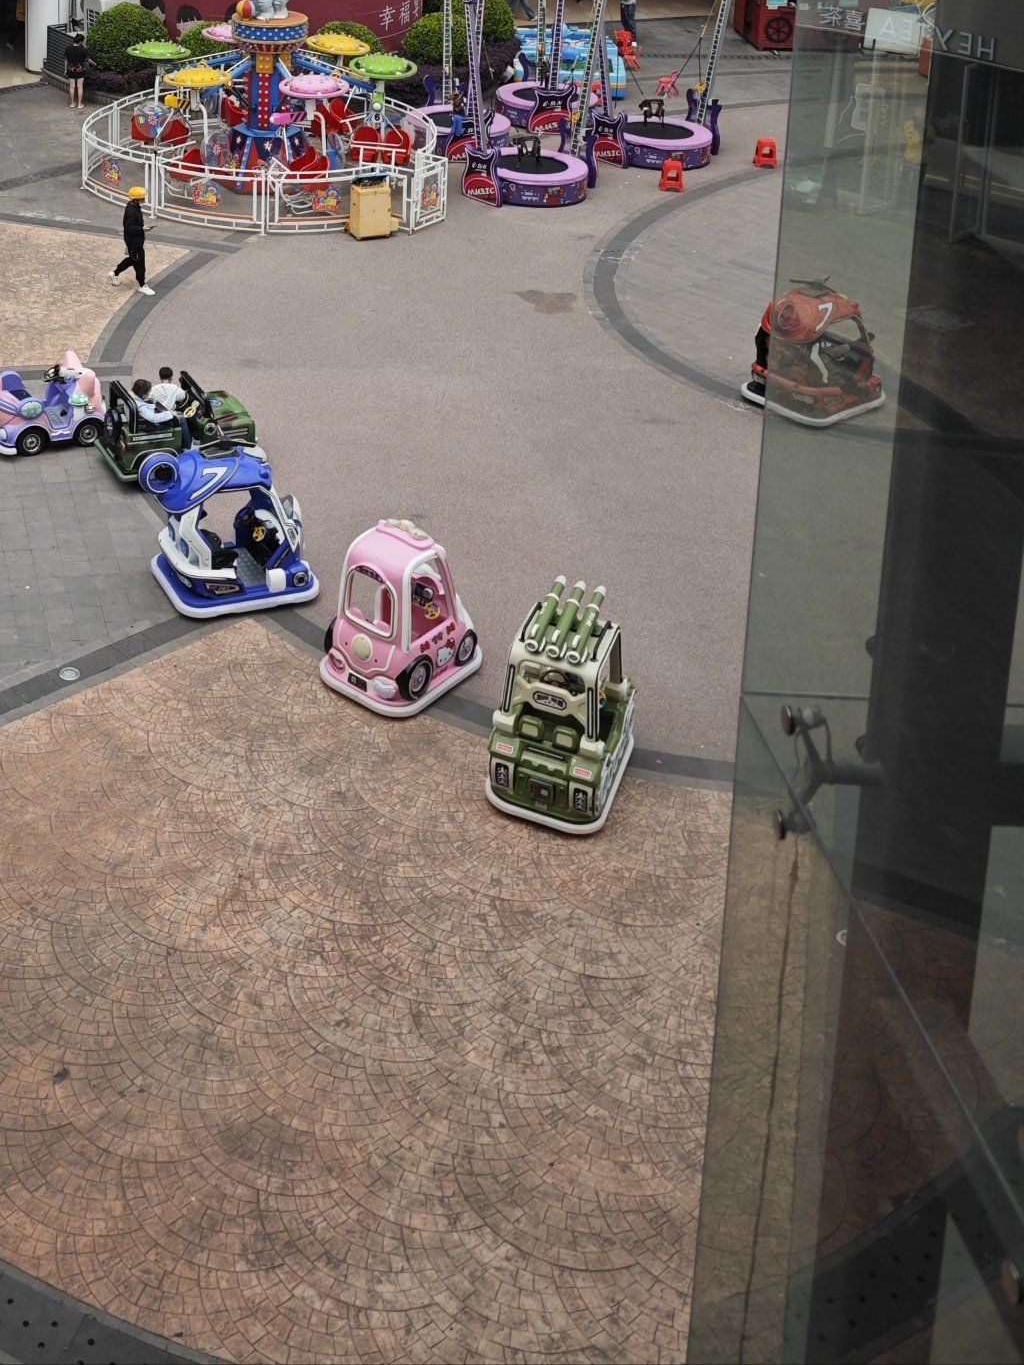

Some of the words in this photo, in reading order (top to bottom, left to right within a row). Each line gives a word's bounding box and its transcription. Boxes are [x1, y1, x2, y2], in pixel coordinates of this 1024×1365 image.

[467, 186, 496, 196] MUSIC
[815, 301, 833, 332] 7
[189, 465, 229, 501] 7
